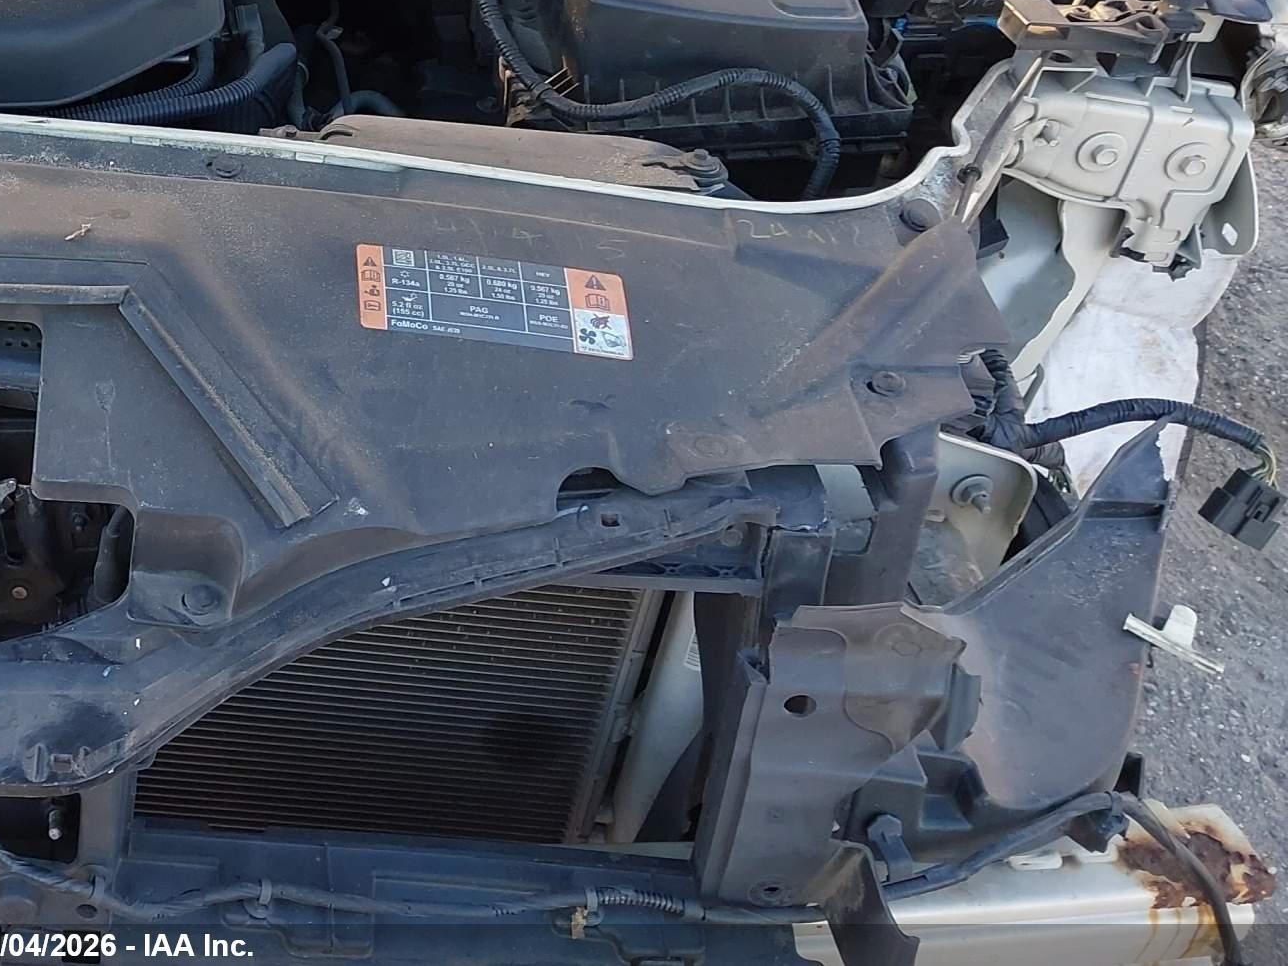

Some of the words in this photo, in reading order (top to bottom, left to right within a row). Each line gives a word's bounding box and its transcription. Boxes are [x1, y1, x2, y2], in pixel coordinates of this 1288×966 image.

[392, 278, 421, 287] R-134a
[392, 300, 404, 308] 5.2
[470, 305, 489, 314] PAG
[539, 314, 559, 323] POE
[391, 319, 429, 330] FoMoCo
